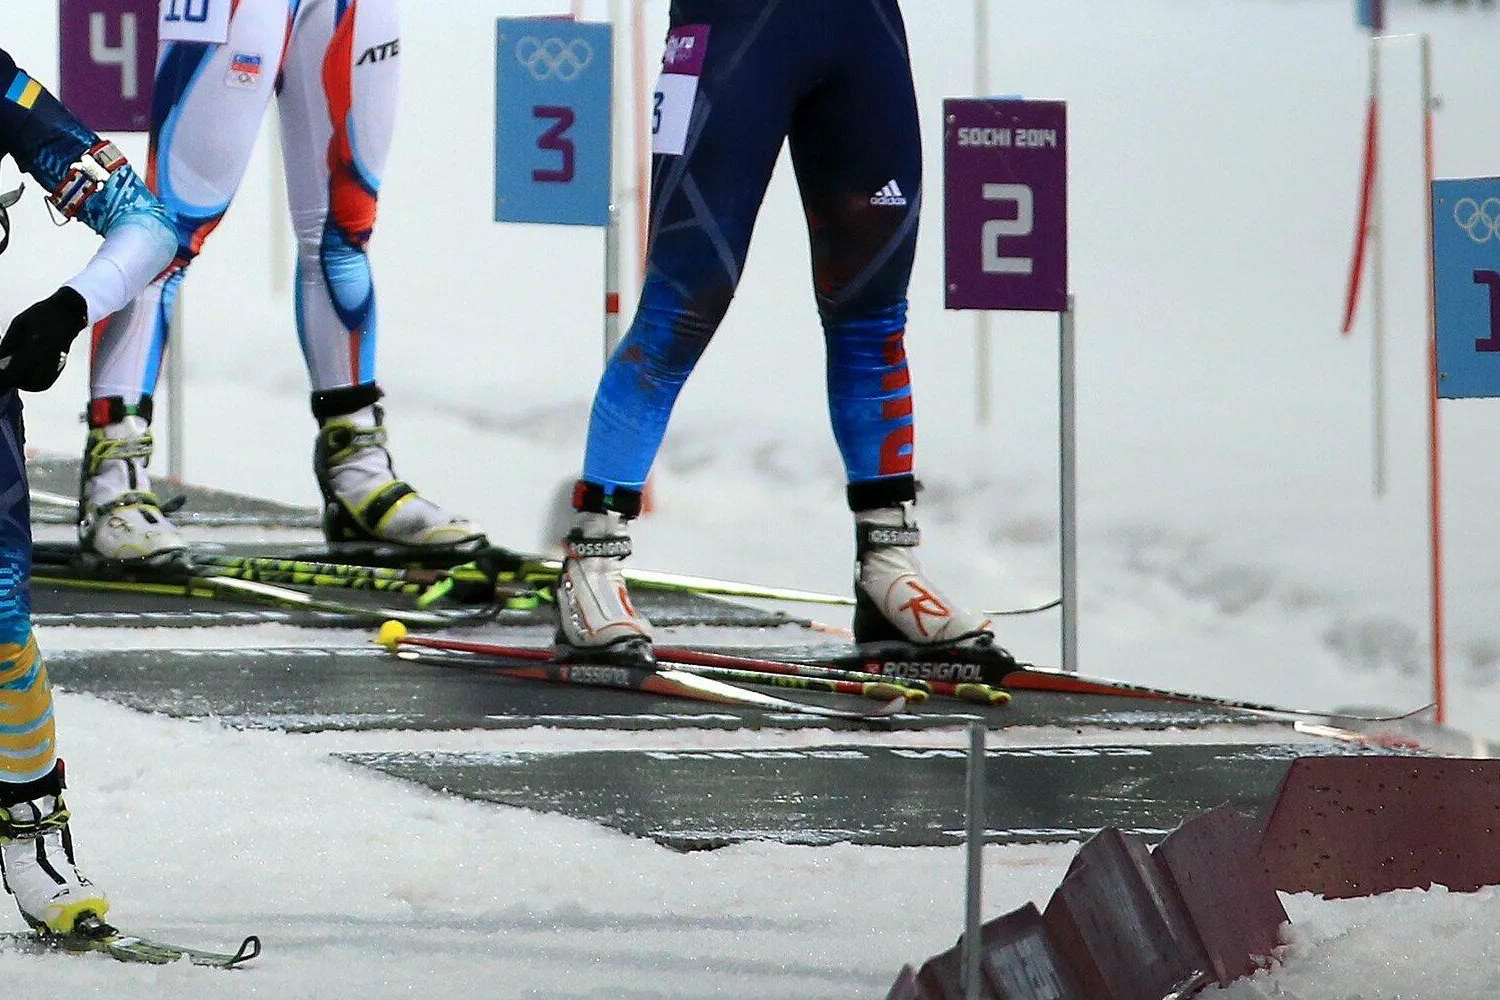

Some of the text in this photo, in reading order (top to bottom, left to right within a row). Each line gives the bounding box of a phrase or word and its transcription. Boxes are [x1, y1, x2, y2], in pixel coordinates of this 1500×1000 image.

[88, 11, 139, 99] 4
[532, 104, 575, 183] 3
[956, 127, 1057, 148] SOCHI 2014
[981, 183, 1034, 275] 2
[883, 661, 983, 682] ROSSIGNOL
